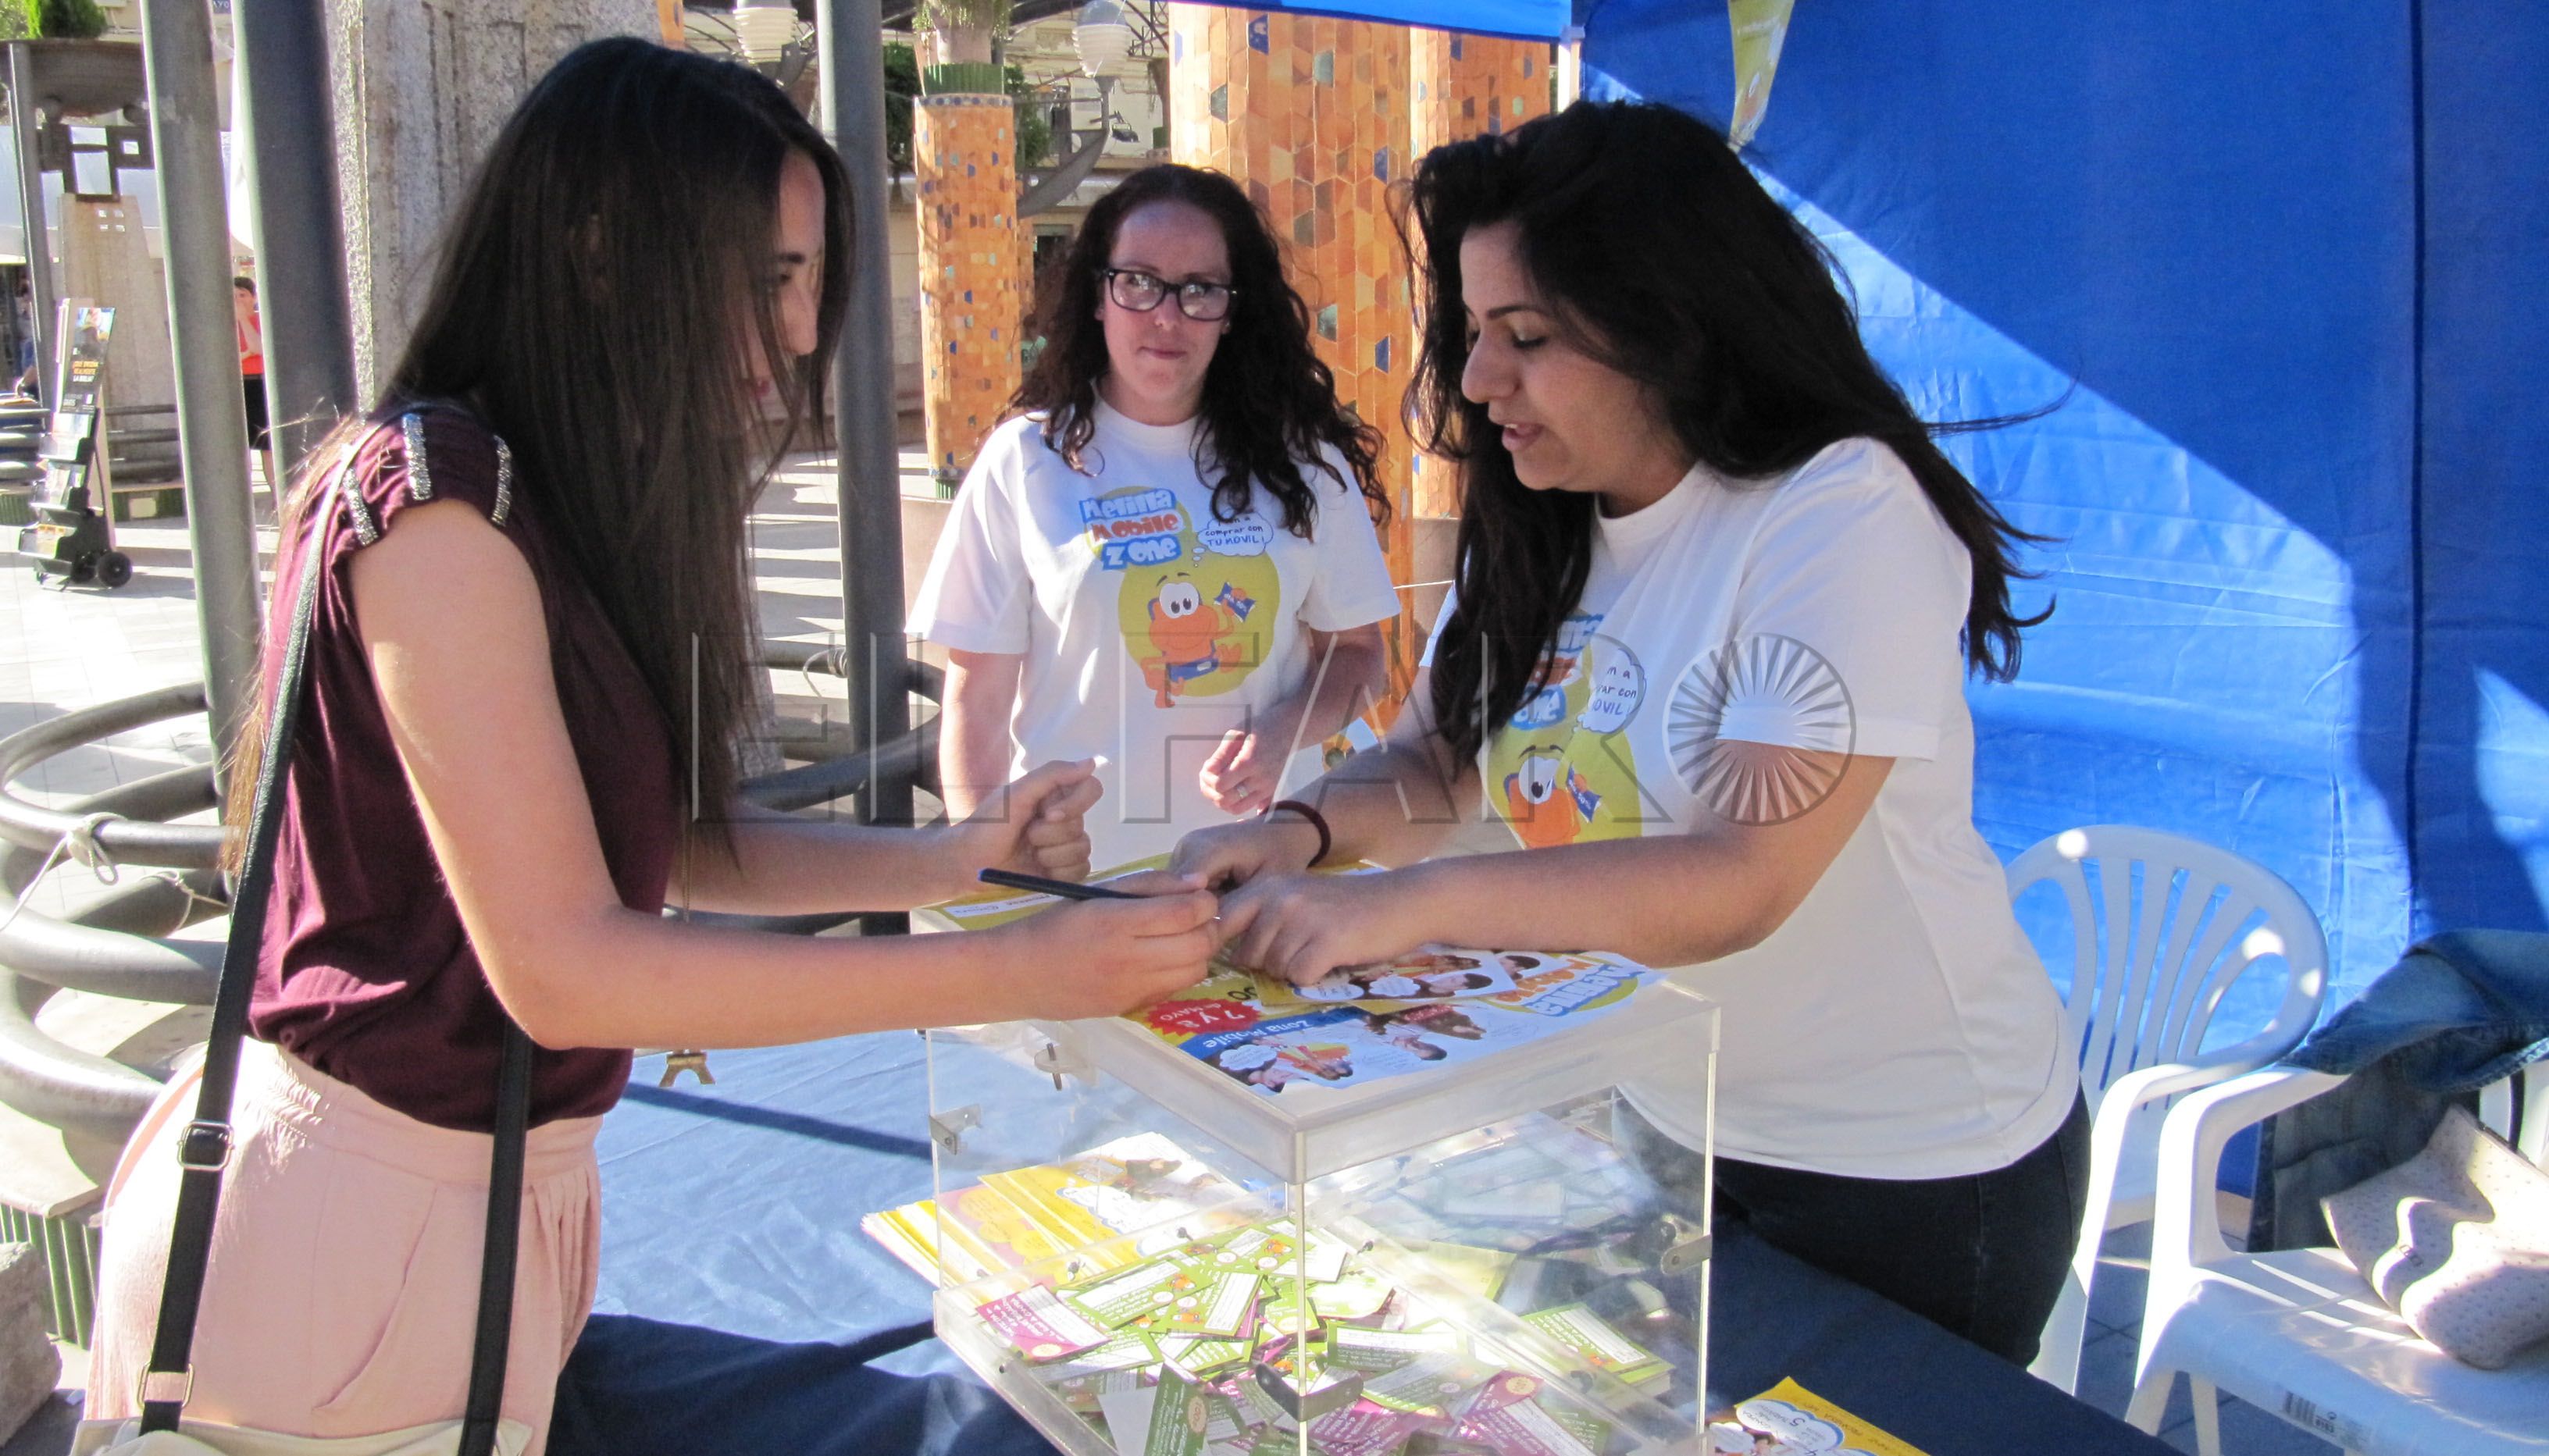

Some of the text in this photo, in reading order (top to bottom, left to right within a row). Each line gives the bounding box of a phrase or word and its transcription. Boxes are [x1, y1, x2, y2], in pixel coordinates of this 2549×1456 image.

[1205, 527, 1244, 537] comprar
[1618, 689, 1637, 699] con
[1224, 1009, 1246, 1020] 7
[1203, 1018, 1315, 1049] Zona Mobile
